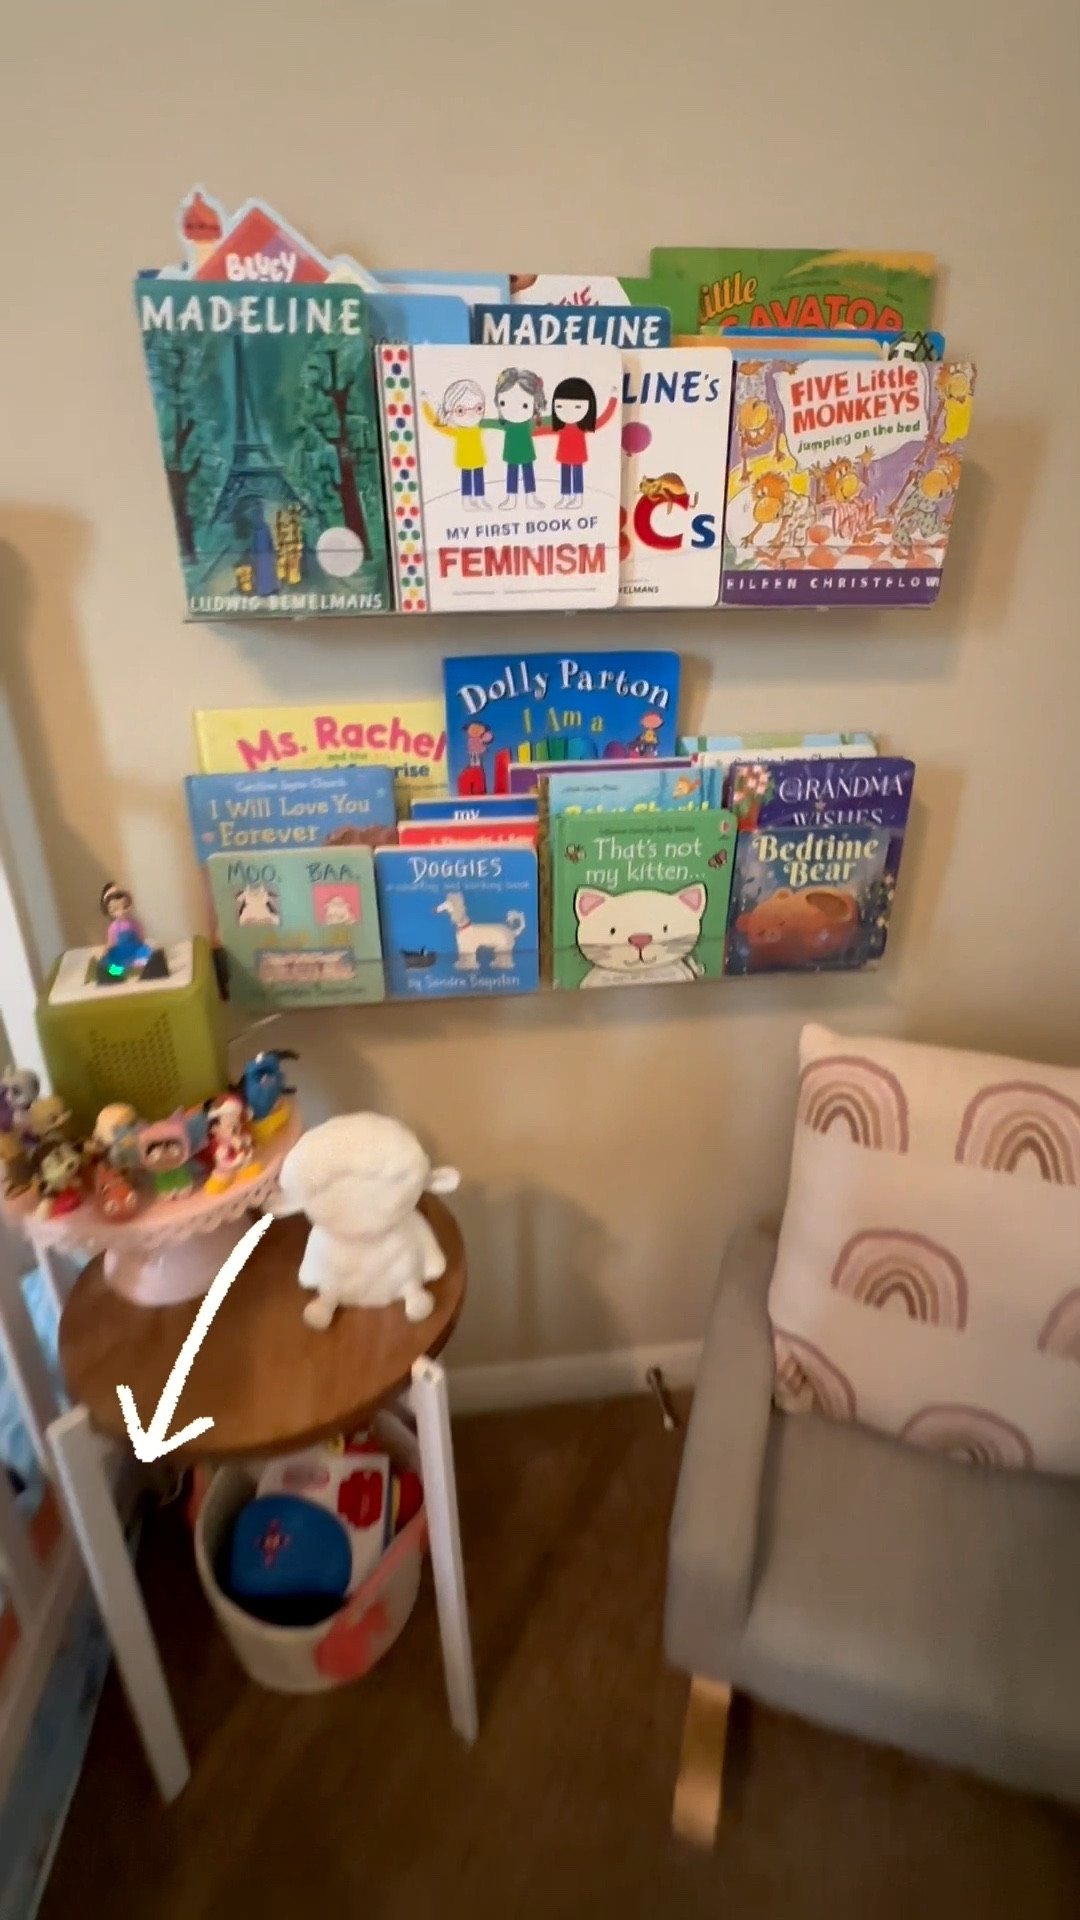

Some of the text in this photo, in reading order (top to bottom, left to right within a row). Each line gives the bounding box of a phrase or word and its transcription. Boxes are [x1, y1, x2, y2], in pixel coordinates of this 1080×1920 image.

[700, 271, 758, 323] ittle
[141, 295, 362, 335] MADELINE
[721, 294, 904, 331] AVATOR
[482, 312, 663, 347] MADELINE
[622, 371, 720, 405] LINE's
[791, 366, 919, 407] FIVE Little
[793, 388, 921, 435] MONKEYS
[797, 420, 921, 453] jumping on the bed
[446, 516, 599, 540] MY FIRST BOOK OF
[619, 493, 717, 563] Cs
[438, 542, 607, 578] FEMINISM
[190, 593, 383, 612] LUDWIG BEMELMANS
[618, 585, 660, 594] ELMANS
[457, 658, 670, 715] Dolly Parton
[523, 706, 605, 734] I Am a
[236, 716, 447, 771] Ms. Rachel
[394, 763, 430, 780] rise
[778, 774, 904, 804] GRANDMA
[209, 792, 370, 822] I Will Love You
[793, 808, 883, 826] WISHES
[219, 821, 320, 848] Forever
[593, 835, 703, 862] That's not
[752, 832, 879, 862] Bedtime
[408, 856, 503, 884] DOGGIES
[586, 868, 619, 889] my
[783, 859, 857, 888] Bear
